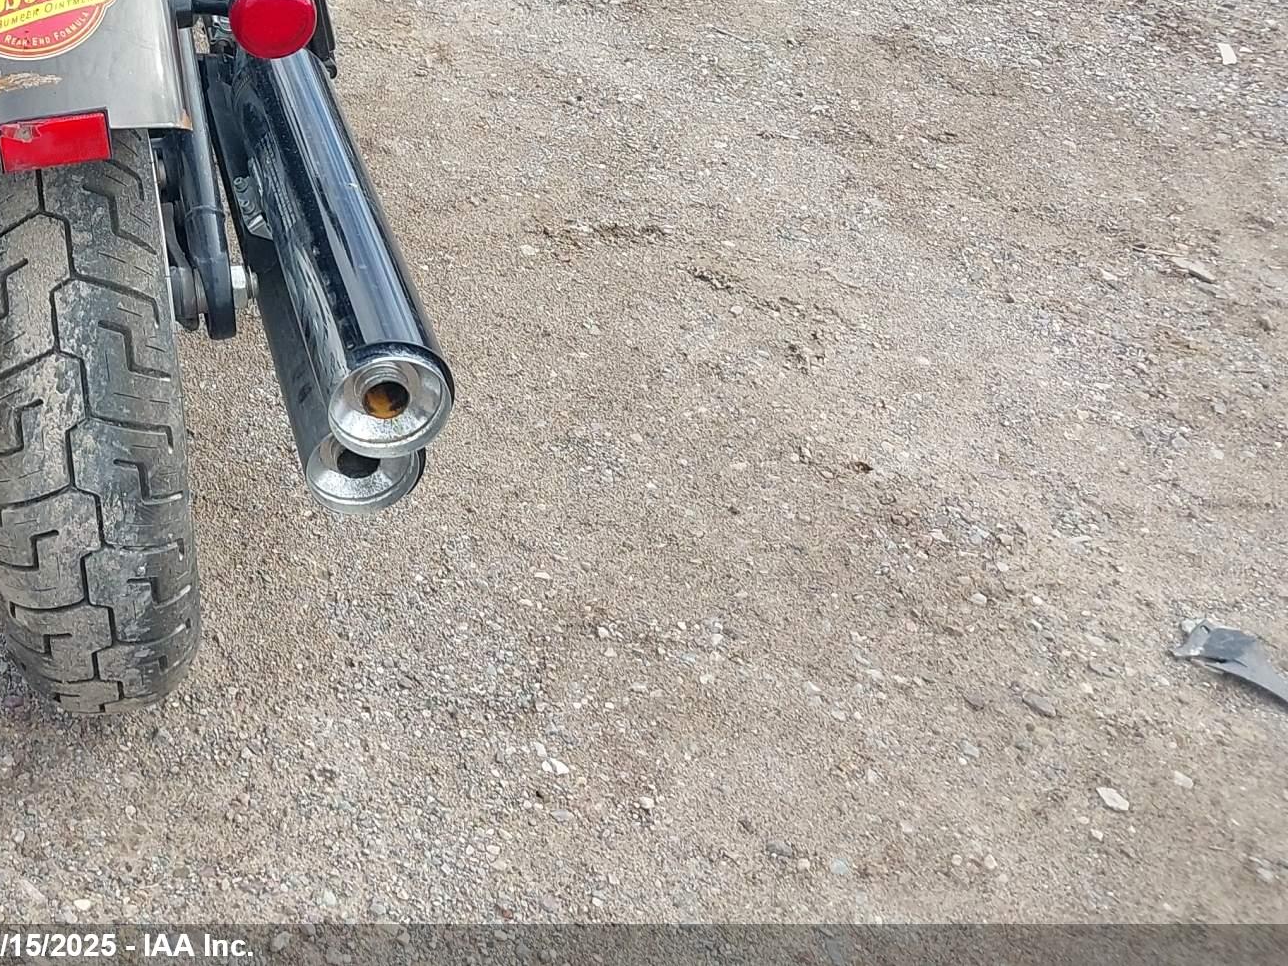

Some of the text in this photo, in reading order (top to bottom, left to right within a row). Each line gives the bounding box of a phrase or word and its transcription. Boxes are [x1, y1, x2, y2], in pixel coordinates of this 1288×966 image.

[4, 10, 90, 47] REAR END FORMULA
